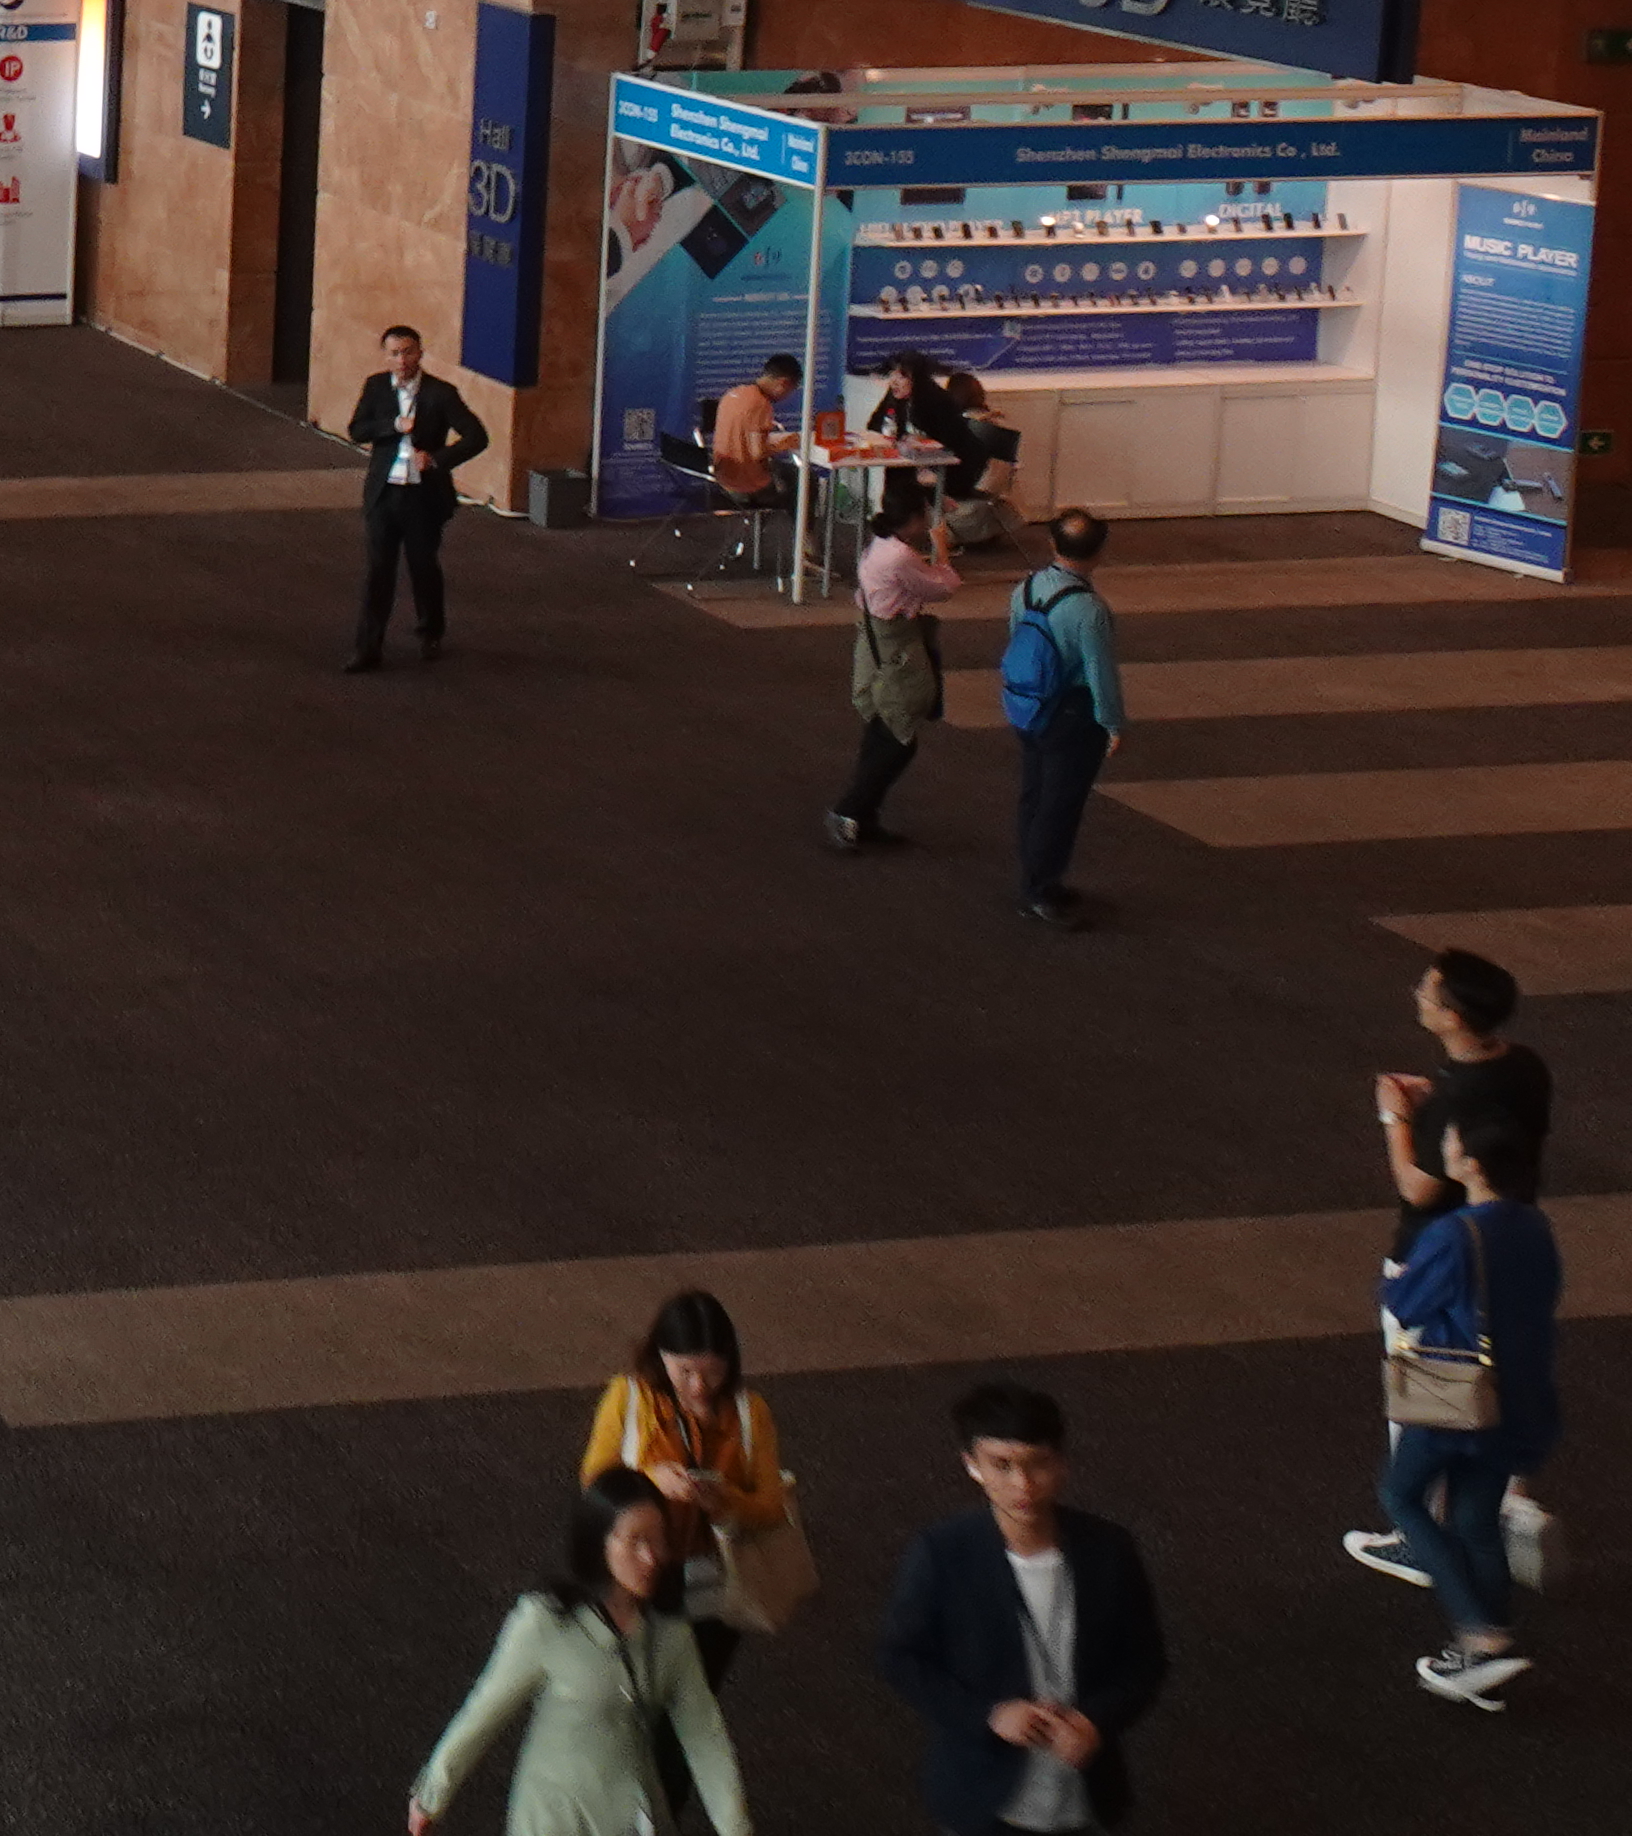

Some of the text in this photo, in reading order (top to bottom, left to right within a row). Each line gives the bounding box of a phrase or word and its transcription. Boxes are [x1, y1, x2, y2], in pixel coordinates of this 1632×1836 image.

[479, 117, 512, 151] Hall
[1520, 127, 1588, 143] Mainland
[1016, 147, 1097, 163] Shenzhen
[1187, 144, 1271, 159] Electronics
[1311, 142, 1340, 157] Ltd.
[1533, 148, 1575, 163] China
[468, 159, 516, 224] 3D
[1217, 202, 1283, 218] DIGITAL
[1463, 233, 1514, 256] MUSIC
[1516, 243, 1580, 269] PLAYER
